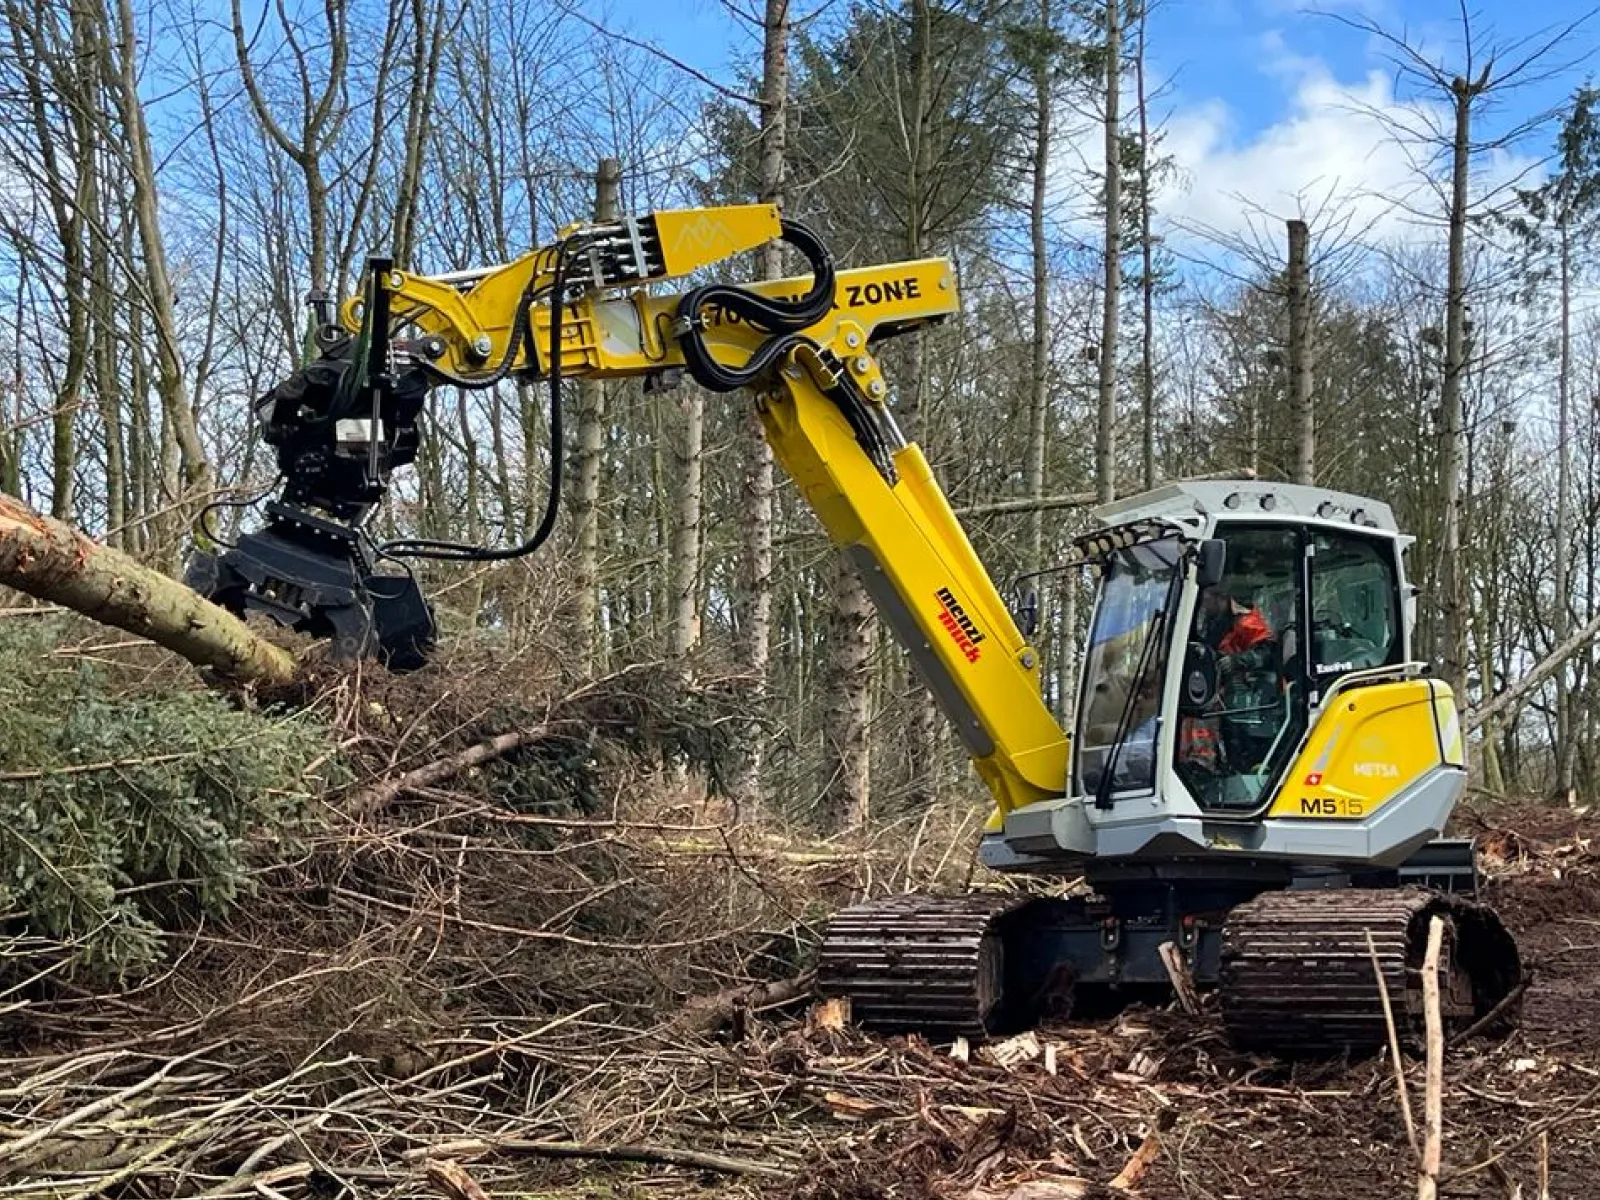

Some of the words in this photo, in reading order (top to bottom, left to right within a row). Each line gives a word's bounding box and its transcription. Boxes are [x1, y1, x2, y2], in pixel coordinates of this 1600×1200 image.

[845, 277, 922, 308] ZONE
[936, 587, 986, 645] menzi
[938, 611, 980, 663] muck
[1353, 762, 1399, 777] METSA
[1301, 798, 1363, 815] M515
